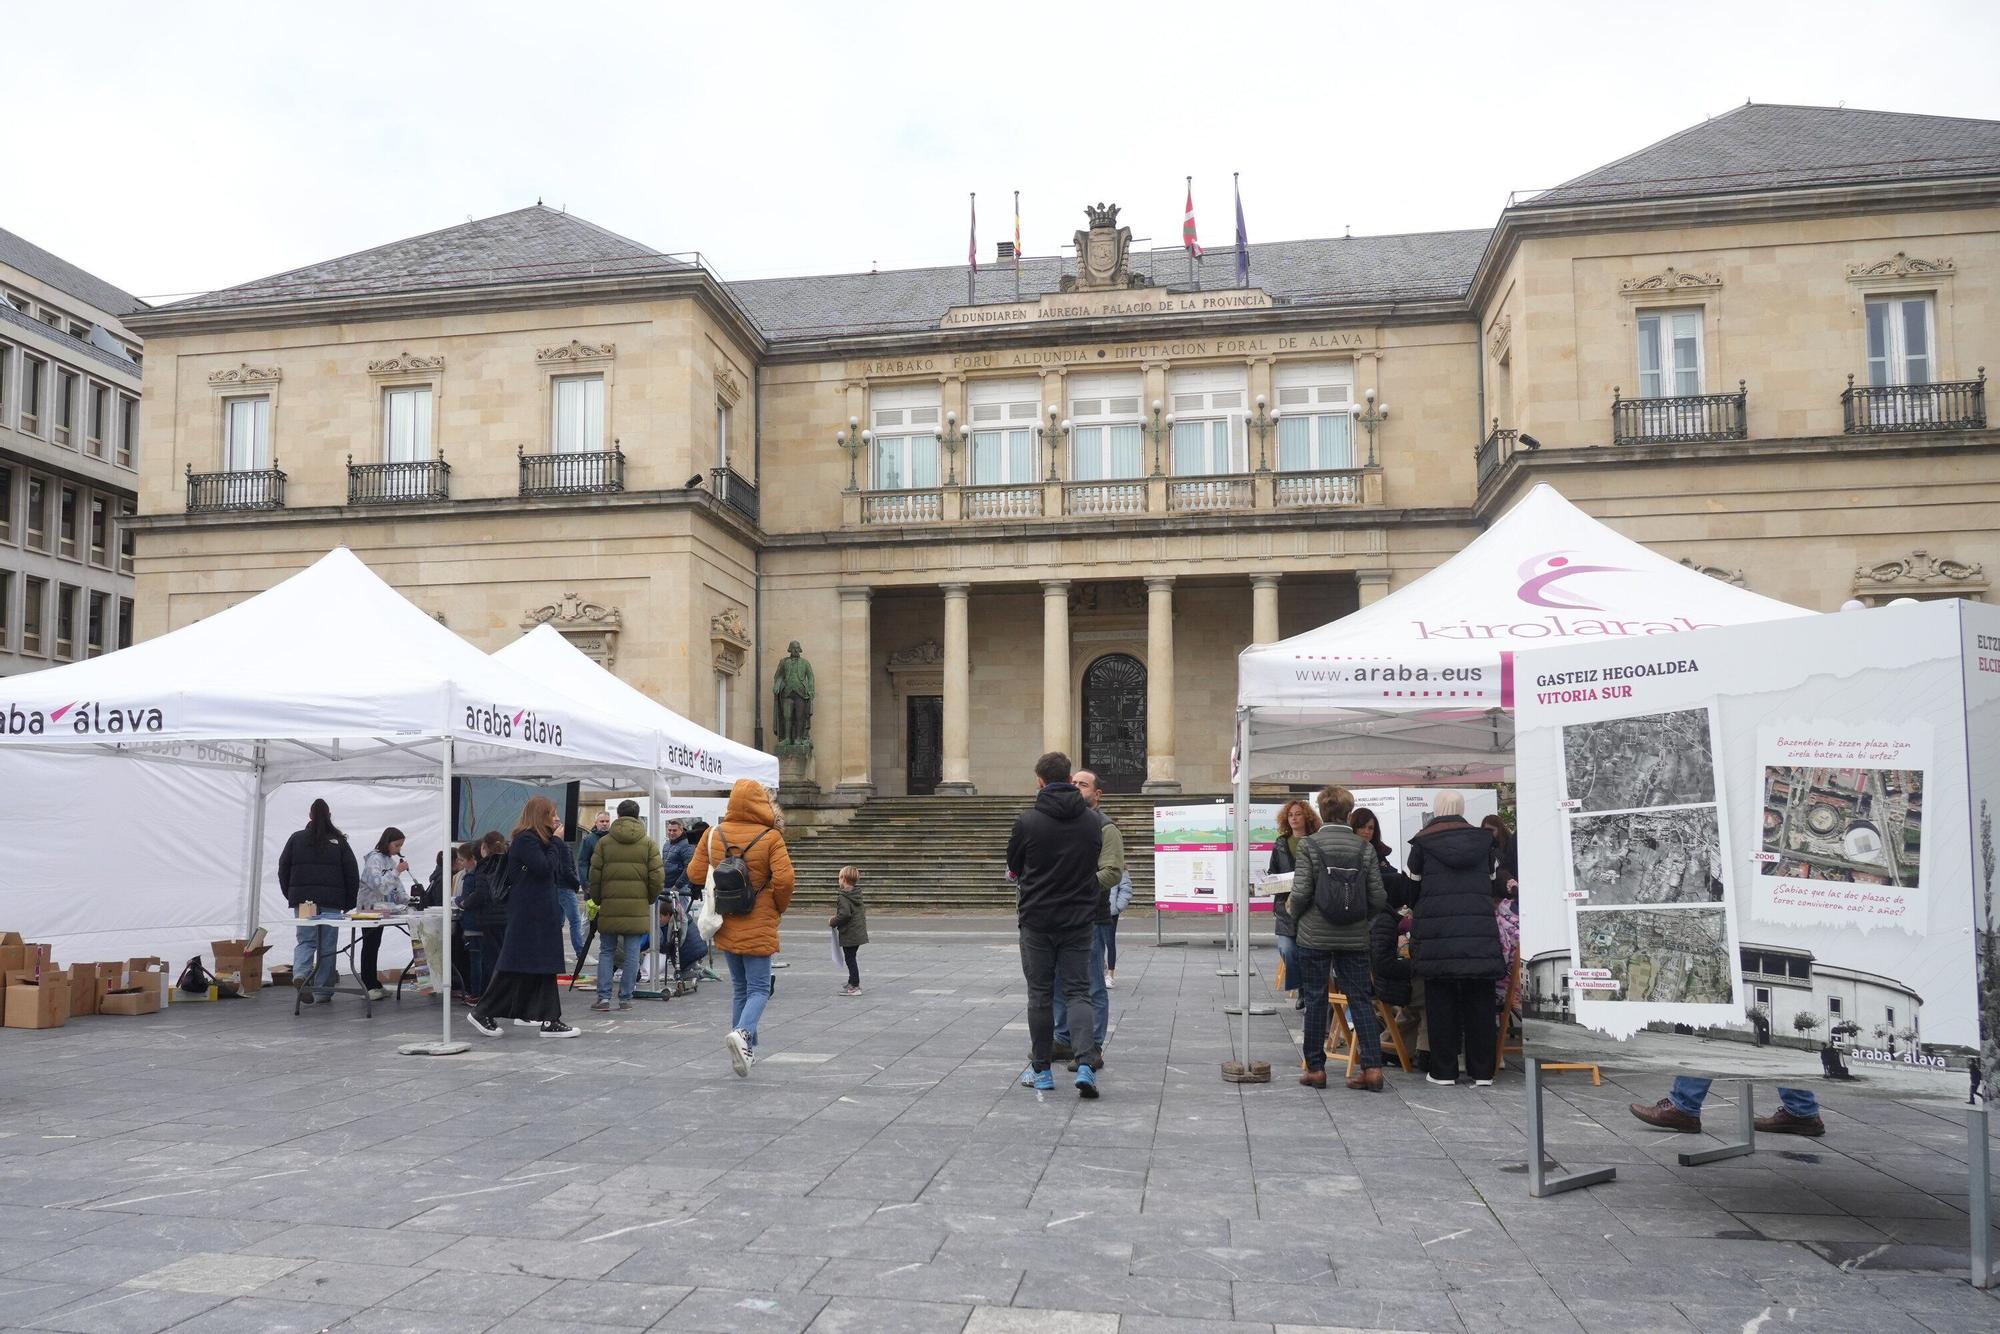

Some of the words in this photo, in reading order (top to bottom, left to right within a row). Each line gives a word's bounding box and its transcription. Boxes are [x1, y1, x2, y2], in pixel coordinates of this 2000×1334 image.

[946, 309, 1027, 324] ALDUNDIAREN
[1038, 306, 1091, 319] JAUREGIA
[1103, 302, 1152, 315] PALACIO
[1159, 301, 1173, 311] DE
[1180, 299, 1196, 310] LA
[1203, 296, 1266, 308] PROVINCIA
[865, 359, 934, 374] ARABAKO
[953, 355, 992, 369] FORU
[1013, 350, 1088, 365] ALDUNDIA
[1115, 343, 1206, 359] DIPUTACION
[1217, 340, 1268, 353] FORAL
[1279, 337, 1297, 349] DE
[1310, 334, 1363, 347] ALAVA
[1295, 664, 1483, 682] www.araba.eus
[1536, 669, 1598, 687] GASTEIZ
[1602, 659, 1699, 681] HEGOALDEA
[1537, 688, 1598, 704] VITORIA
[1602, 685, 1633, 700] SUR
[73, 702, 163, 734] álava
[466, 704, 511, 738] araba
[524, 711, 562, 747] álava
[1777, 737, 1824, 747] Bazenekien
[1827, 738, 1836, 747] bi
[1864, 739, 1889, 750] plaza
[1892, 740, 1911, 749] izan
[668, 744, 694, 769] araba
[700, 750, 722, 775] álava
[1788, 749, 1810, 758] zirela
[1814, 750, 1843, 759] batera
[1846, 751, 1854, 759] ia
[1858, 751, 1866, 759] bi
[1754, 853, 1775, 861] 2006
[1811, 889, 1825, 899] que
[1827, 888, 1841, 898] las
[1844, 889, 1858, 900] dos
[1862, 892, 1891, 903] plazas
[1894, 895, 1904, 904] de
[1773, 896, 1794, 905] toros
[1797, 899, 1843, 910] convivieron
[1847, 904, 1865, 912] casi
[1868, 905, 1874, 913] 2
[1877, 906, 1906, 916] años?
[1851, 1048, 1892, 1062] araba
[1903, 1048, 1946, 1067] álava
